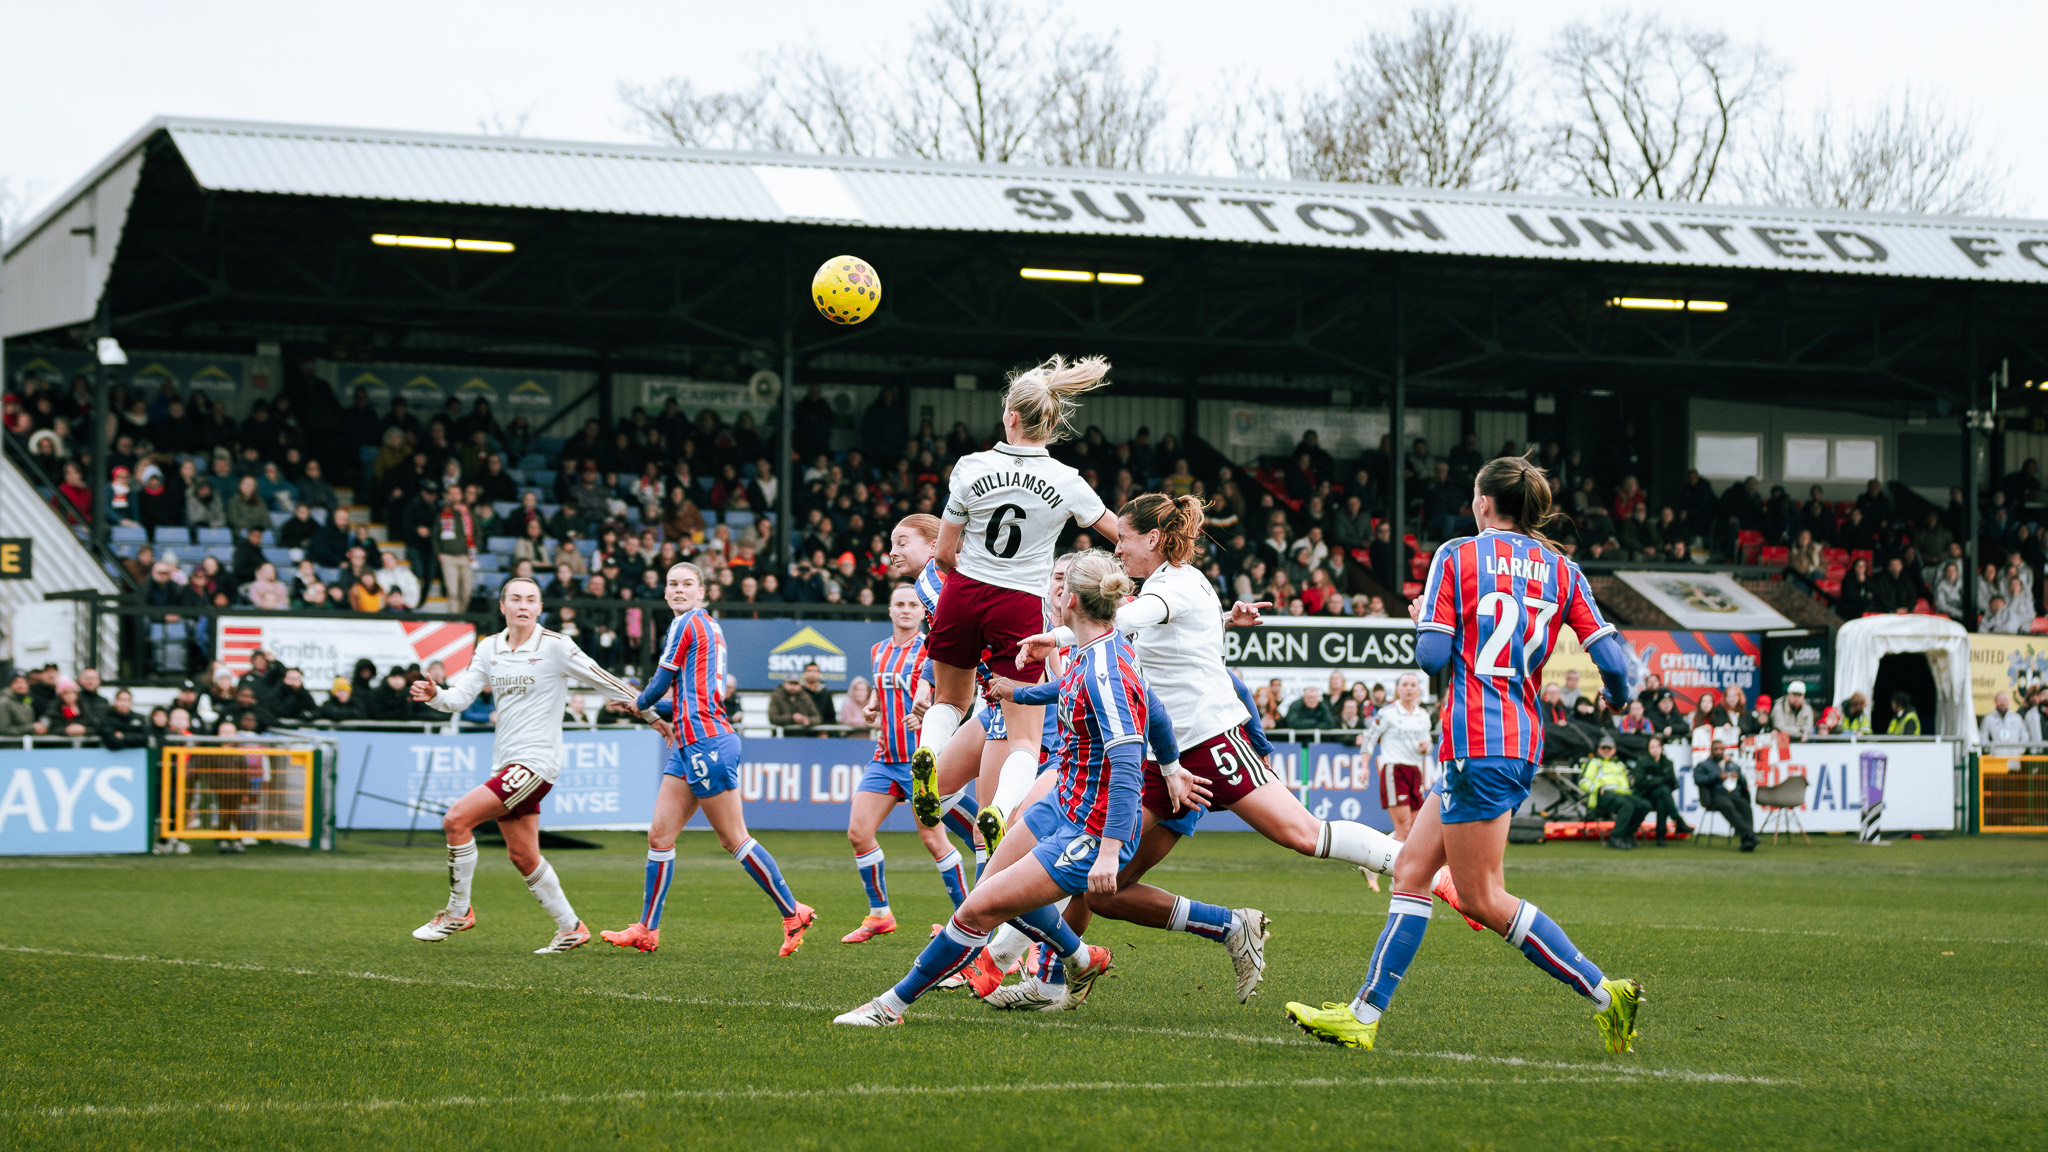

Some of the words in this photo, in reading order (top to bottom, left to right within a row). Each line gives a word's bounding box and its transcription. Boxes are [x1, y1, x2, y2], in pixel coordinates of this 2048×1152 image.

[1003, 187, 1447, 241] SUTTON
[1507, 213, 1888, 263] UNITED
[971, 471, 1064, 510] WILLIAMSON
[984, 503, 1027, 559] 6
[1, 543, 21, 573] E
[1485, 555, 1551, 585] LARKIN
[270, 640, 325, 658] Smith
[1225, 631, 1309, 663] BARN
[1318, 632, 1415, 664] GLASS
[1474, 591, 1560, 678] 27
[1660, 653, 1710, 671] CRYSTAL
[1711, 653, 1757, 672] PALACE
[490, 674, 535, 687] Emirates
[873, 671, 912, 690] TEN
[1663, 670, 1721, 688] FOOTBALL
[1722, 671, 1753, 688] CLUB
[409, 746, 477, 772] TEN
[563, 742, 620, 768] TEN
[690, 753, 709, 778] 5
[1210, 742, 1240, 776] 5
[501, 764, 531, 789] 19
[738, 762, 801, 801] UTH
[1271, 752, 1370, 791] ALACE
[0, 766, 135, 833] AYS
[554, 792, 621, 814] NYSE
[1065, 833, 1097, 861] 6
